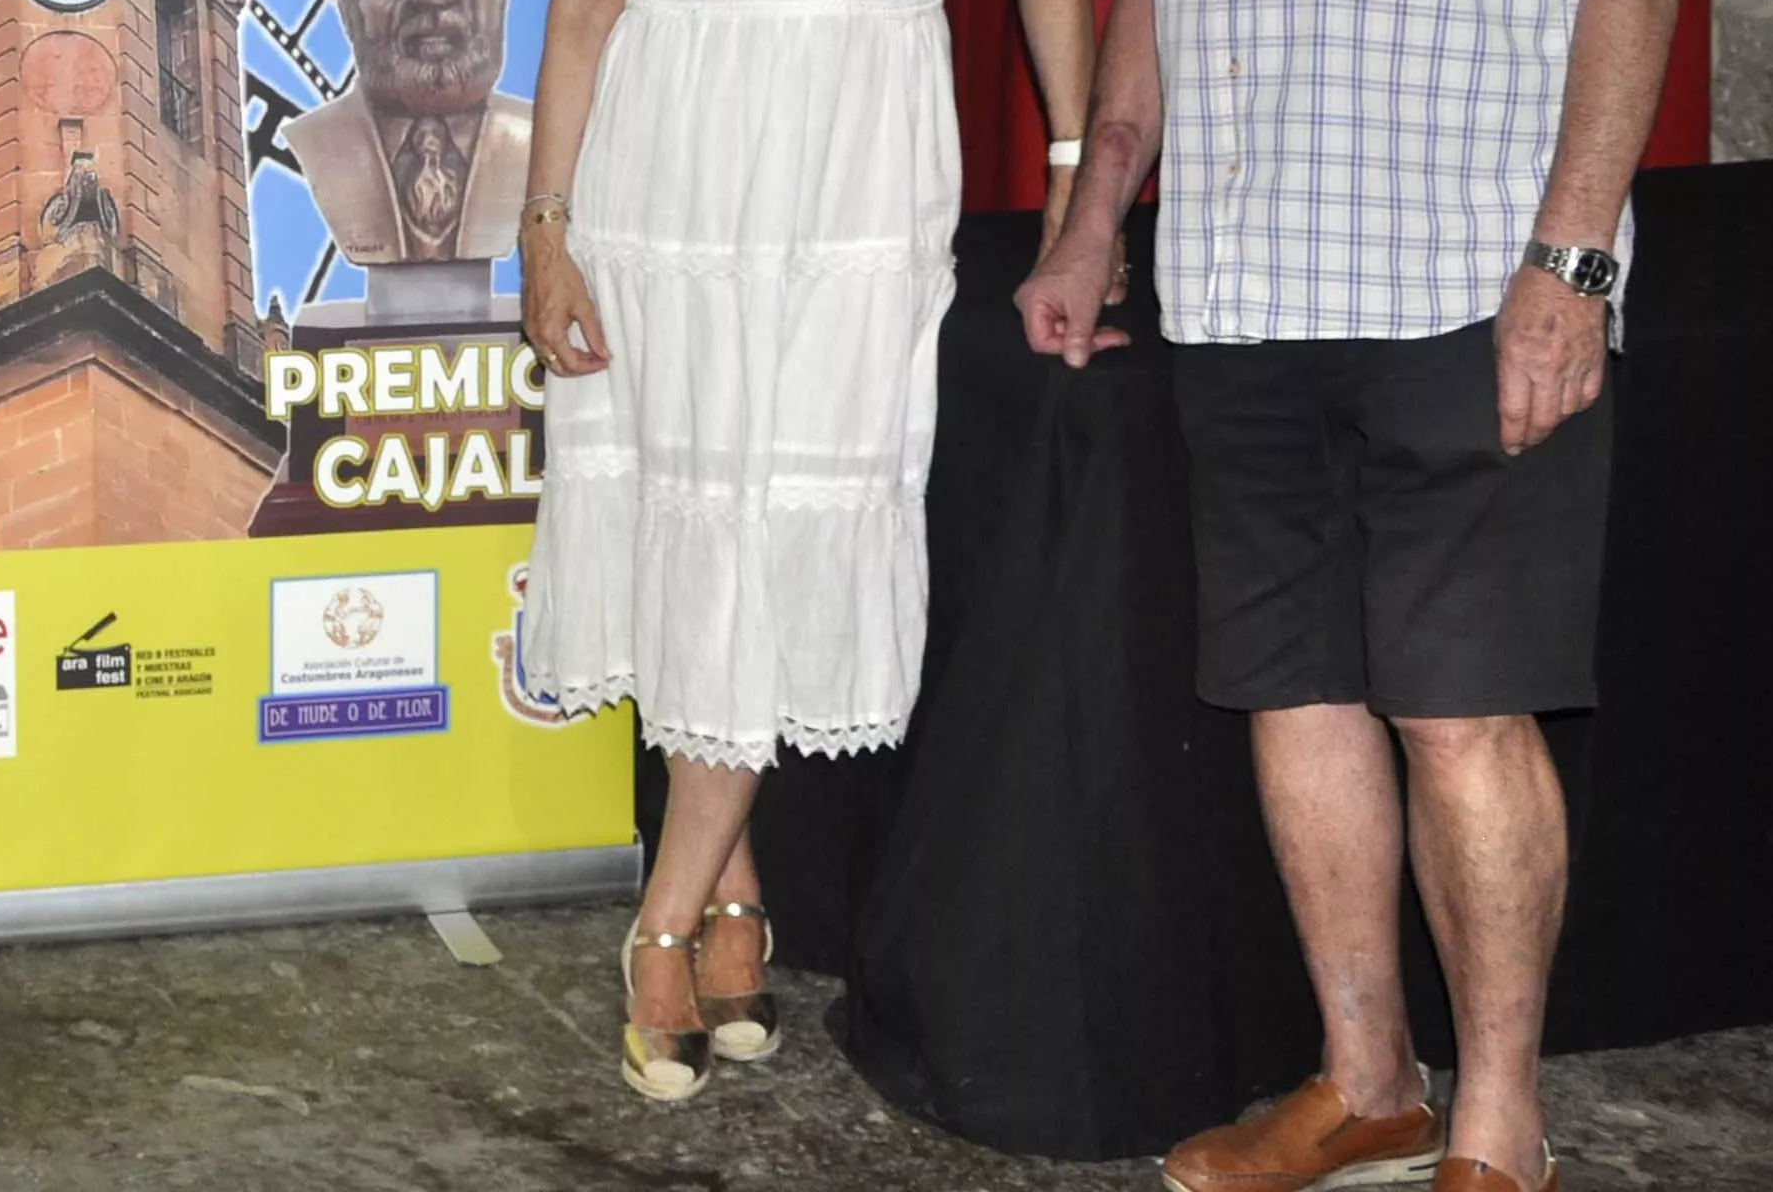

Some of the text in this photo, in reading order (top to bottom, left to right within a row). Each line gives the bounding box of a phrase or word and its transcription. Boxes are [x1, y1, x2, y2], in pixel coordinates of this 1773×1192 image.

[314, 429, 544, 512] CAJAL
[61, 653, 126, 671] ara film
[164, 648, 216, 658] FESTIVALES
[144, 662, 192, 672] MUESTRAS
[281, 666, 424, 684] Costumbres Aragonesas
[95, 669, 126, 685] fest
[269, 707, 289, 727] DE
[347, 702, 359, 721] O
[368, 701, 388, 720] DE
